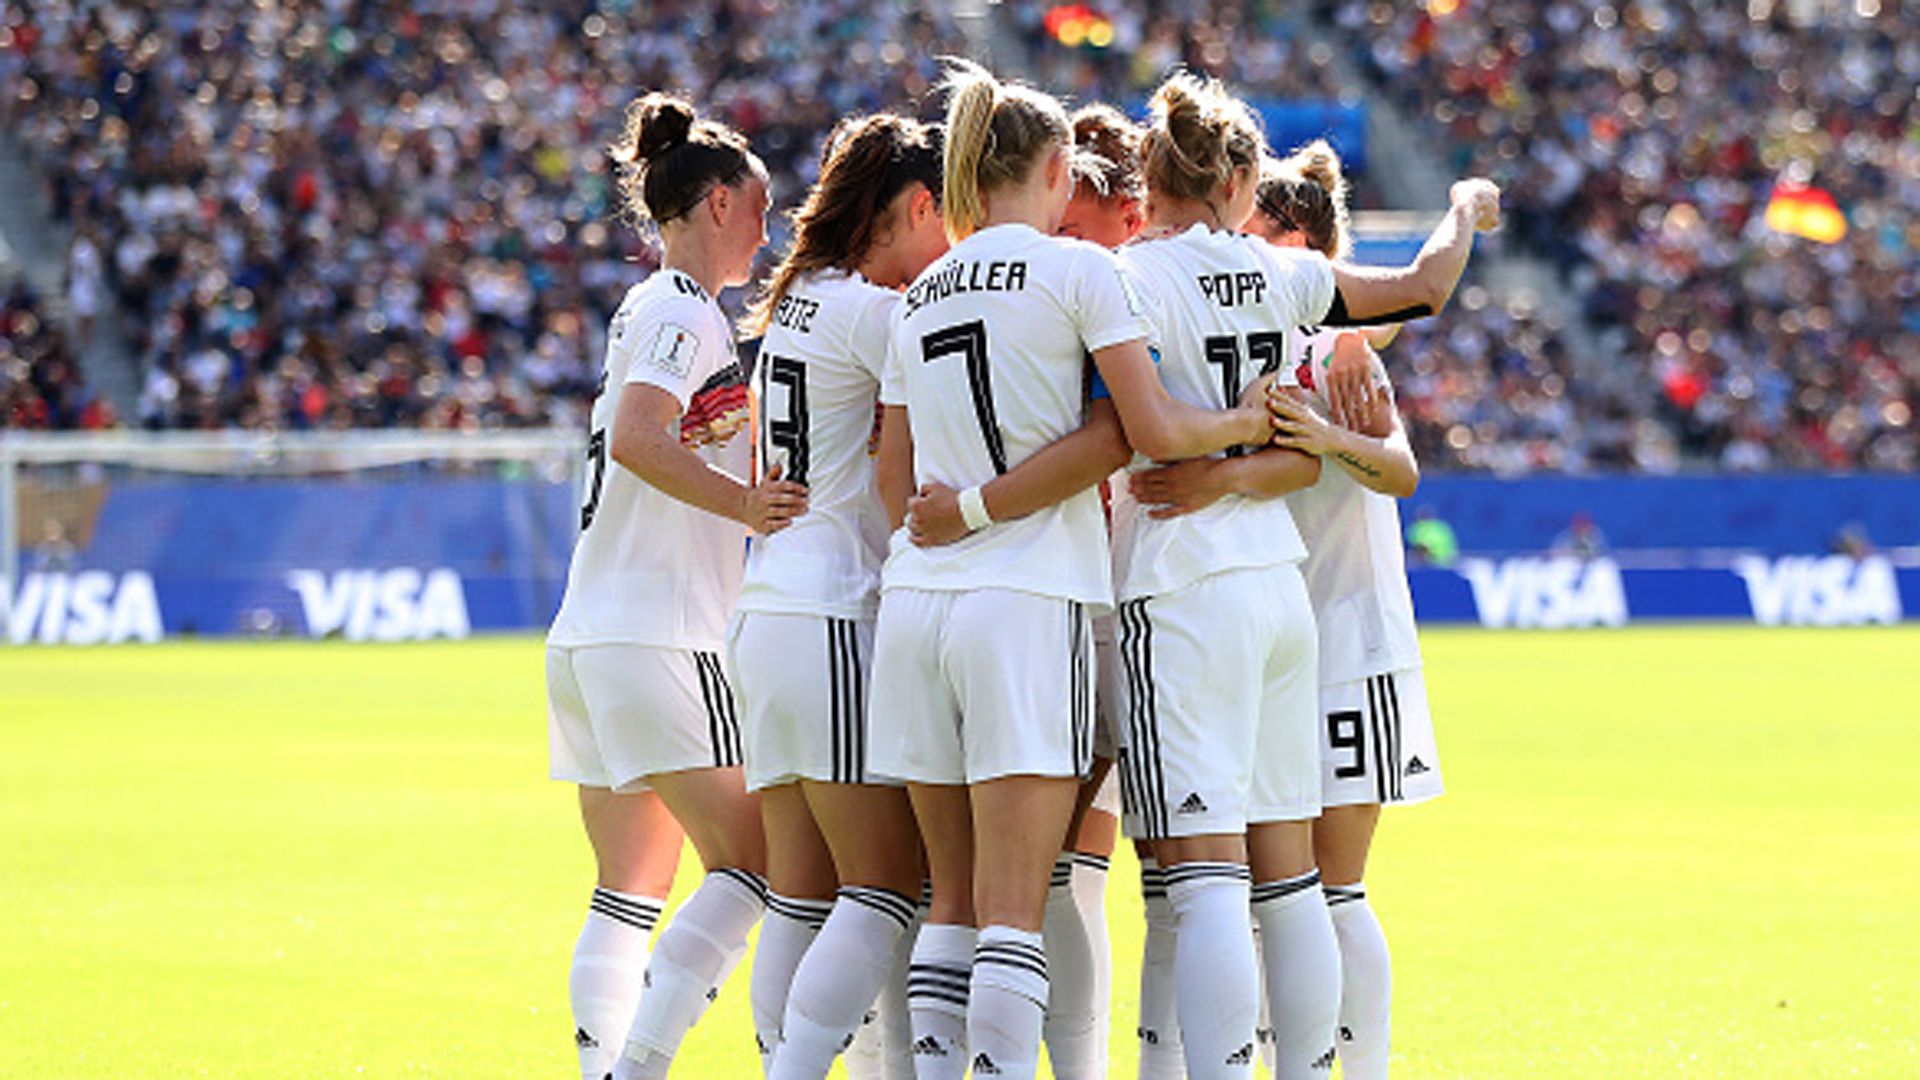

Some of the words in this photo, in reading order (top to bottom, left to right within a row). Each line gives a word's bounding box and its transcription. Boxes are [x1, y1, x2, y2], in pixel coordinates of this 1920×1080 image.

[1197, 272, 1266, 306] POPP
[761, 352, 809, 486] 13
[921, 319, 1007, 475] 7
[0, 570, 164, 645] VISA
[286, 568, 471, 640] VISA
[1458, 556, 1629, 627] VISA
[1730, 555, 1902, 626] VISA
[1327, 710, 1367, 779] 9
